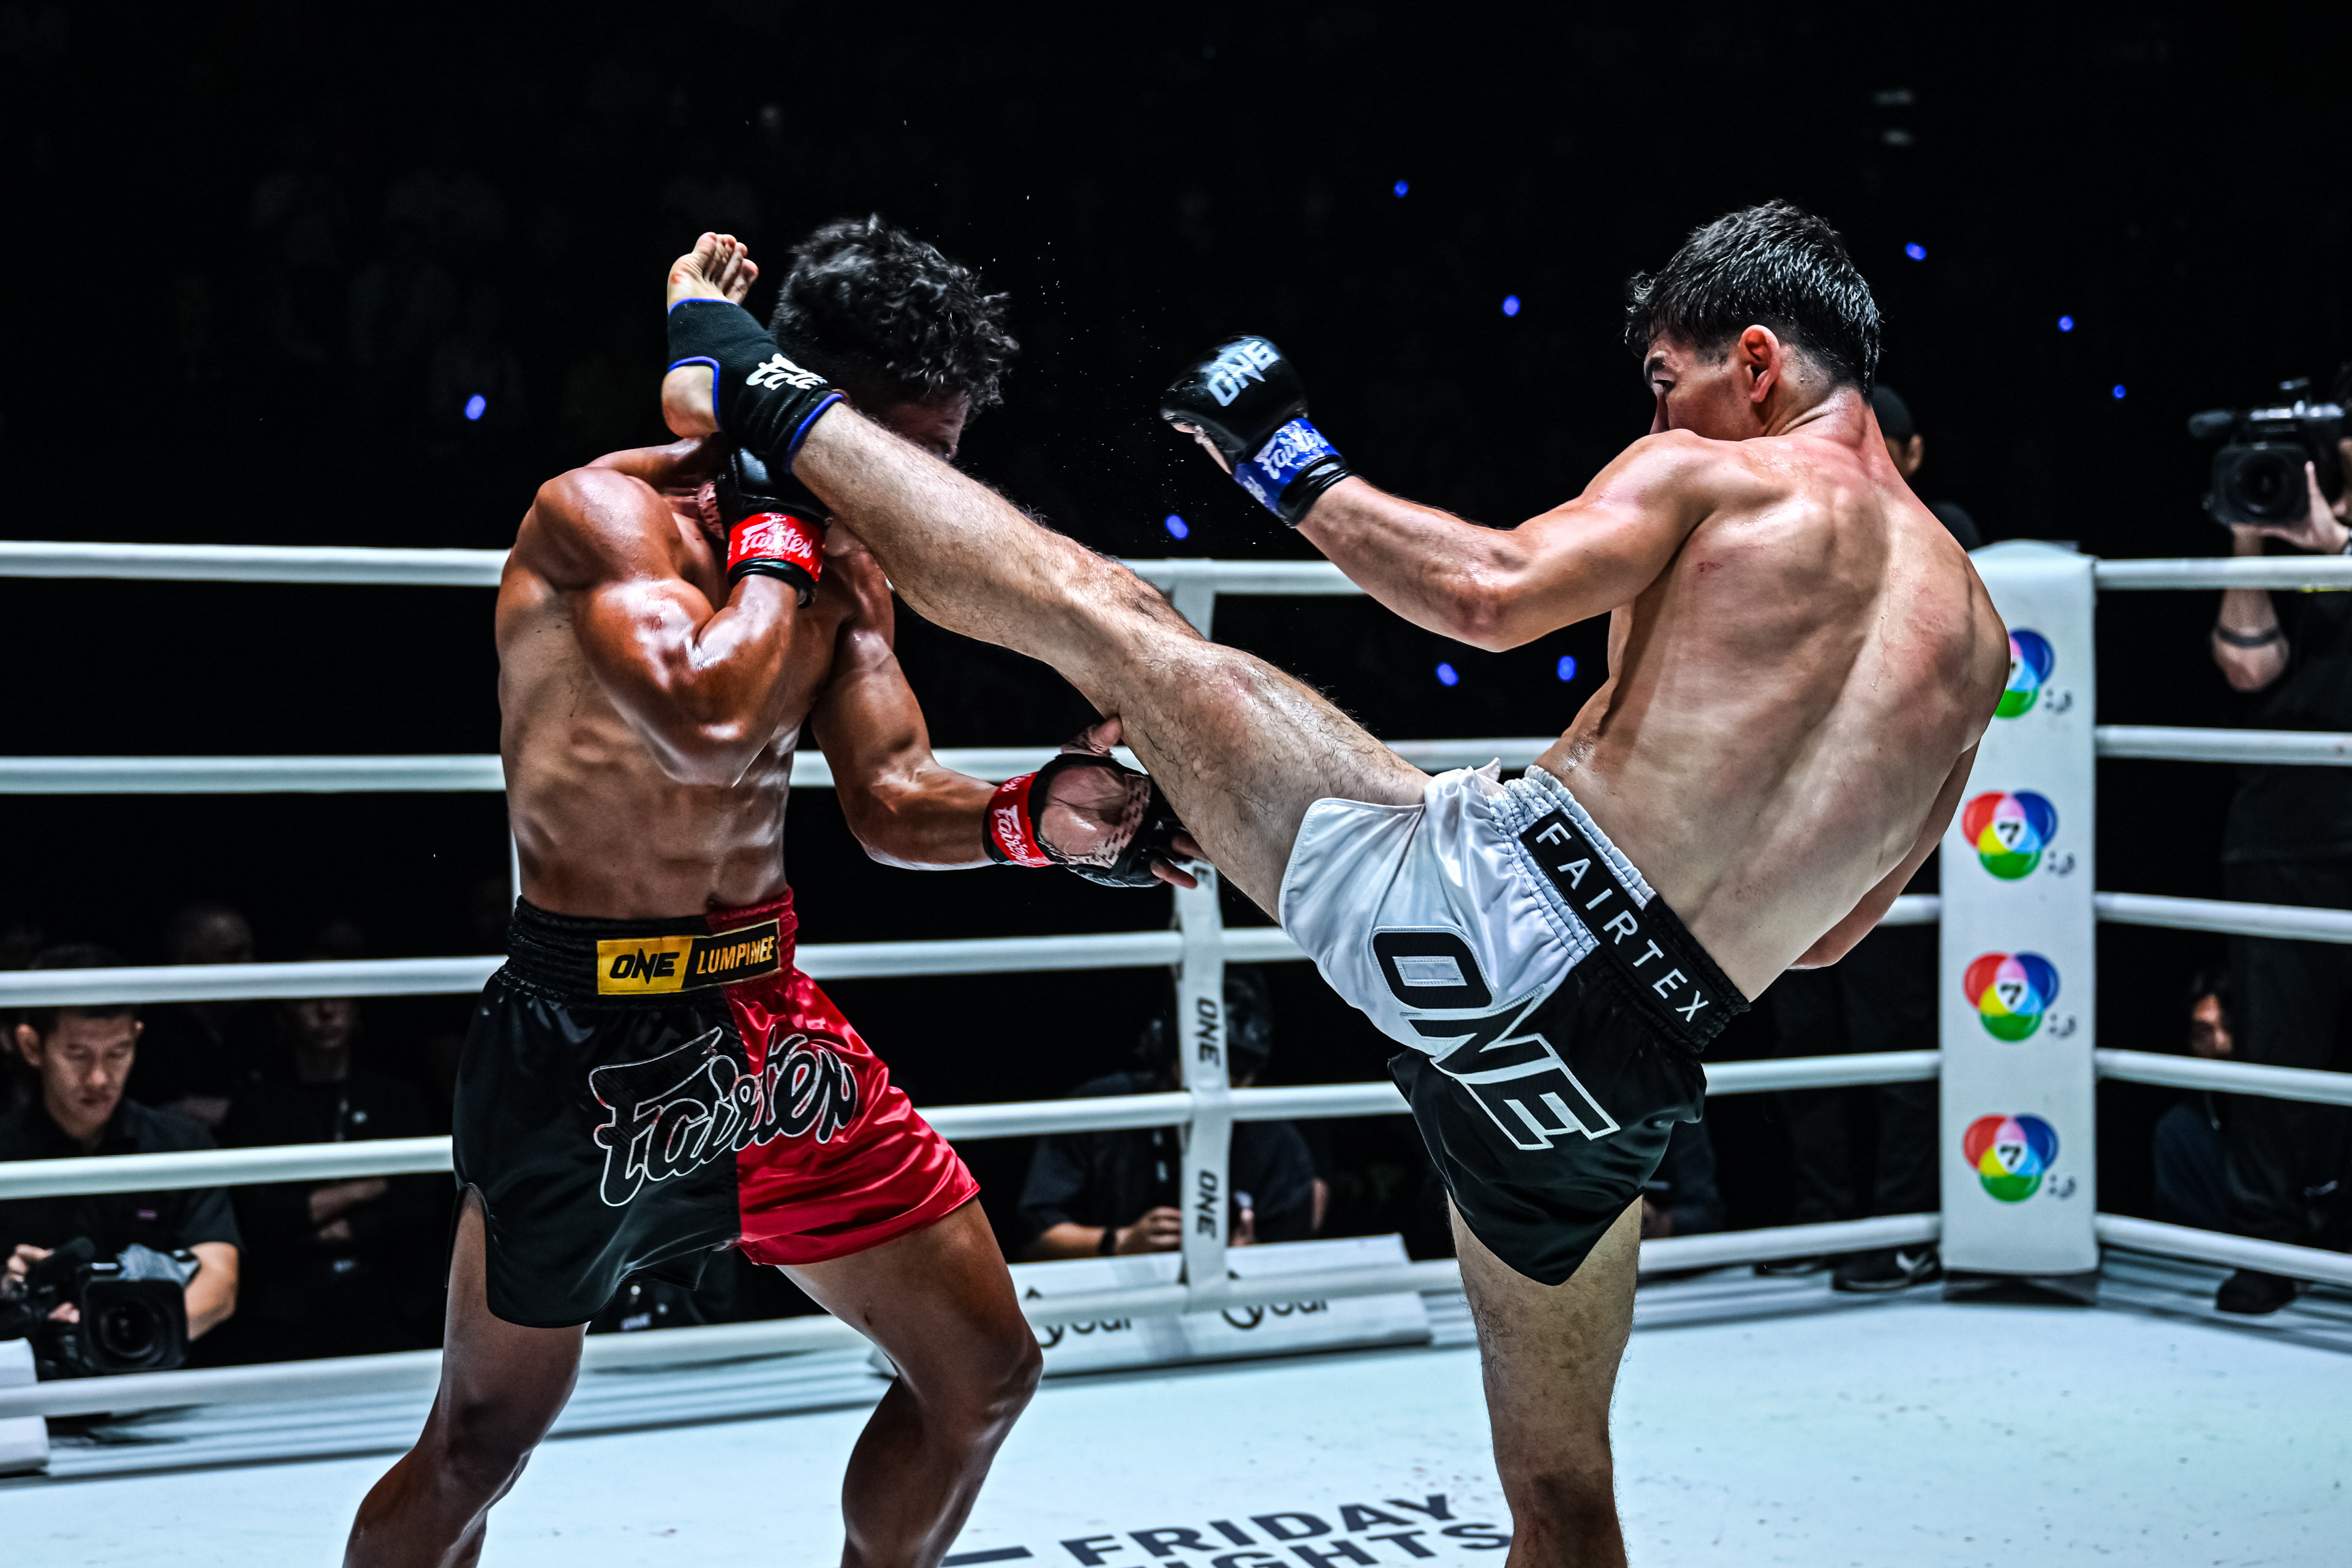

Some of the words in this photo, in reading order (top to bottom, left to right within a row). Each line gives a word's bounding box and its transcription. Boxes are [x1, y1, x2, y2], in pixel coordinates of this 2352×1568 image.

[1207, 341, 1281, 407] ONE
[1535, 821, 1709, 1023] FAIRTEX
[609, 948, 680, 984] ONE
[696, 936, 775, 974] LUMPINEE
[1194, 997, 1220, 1068] ONE
[1368, 925, 1621, 1150] ONE
[1194, 1169, 1220, 1238] ONE
[1059, 1494, 1457, 1567] FRIDAY
